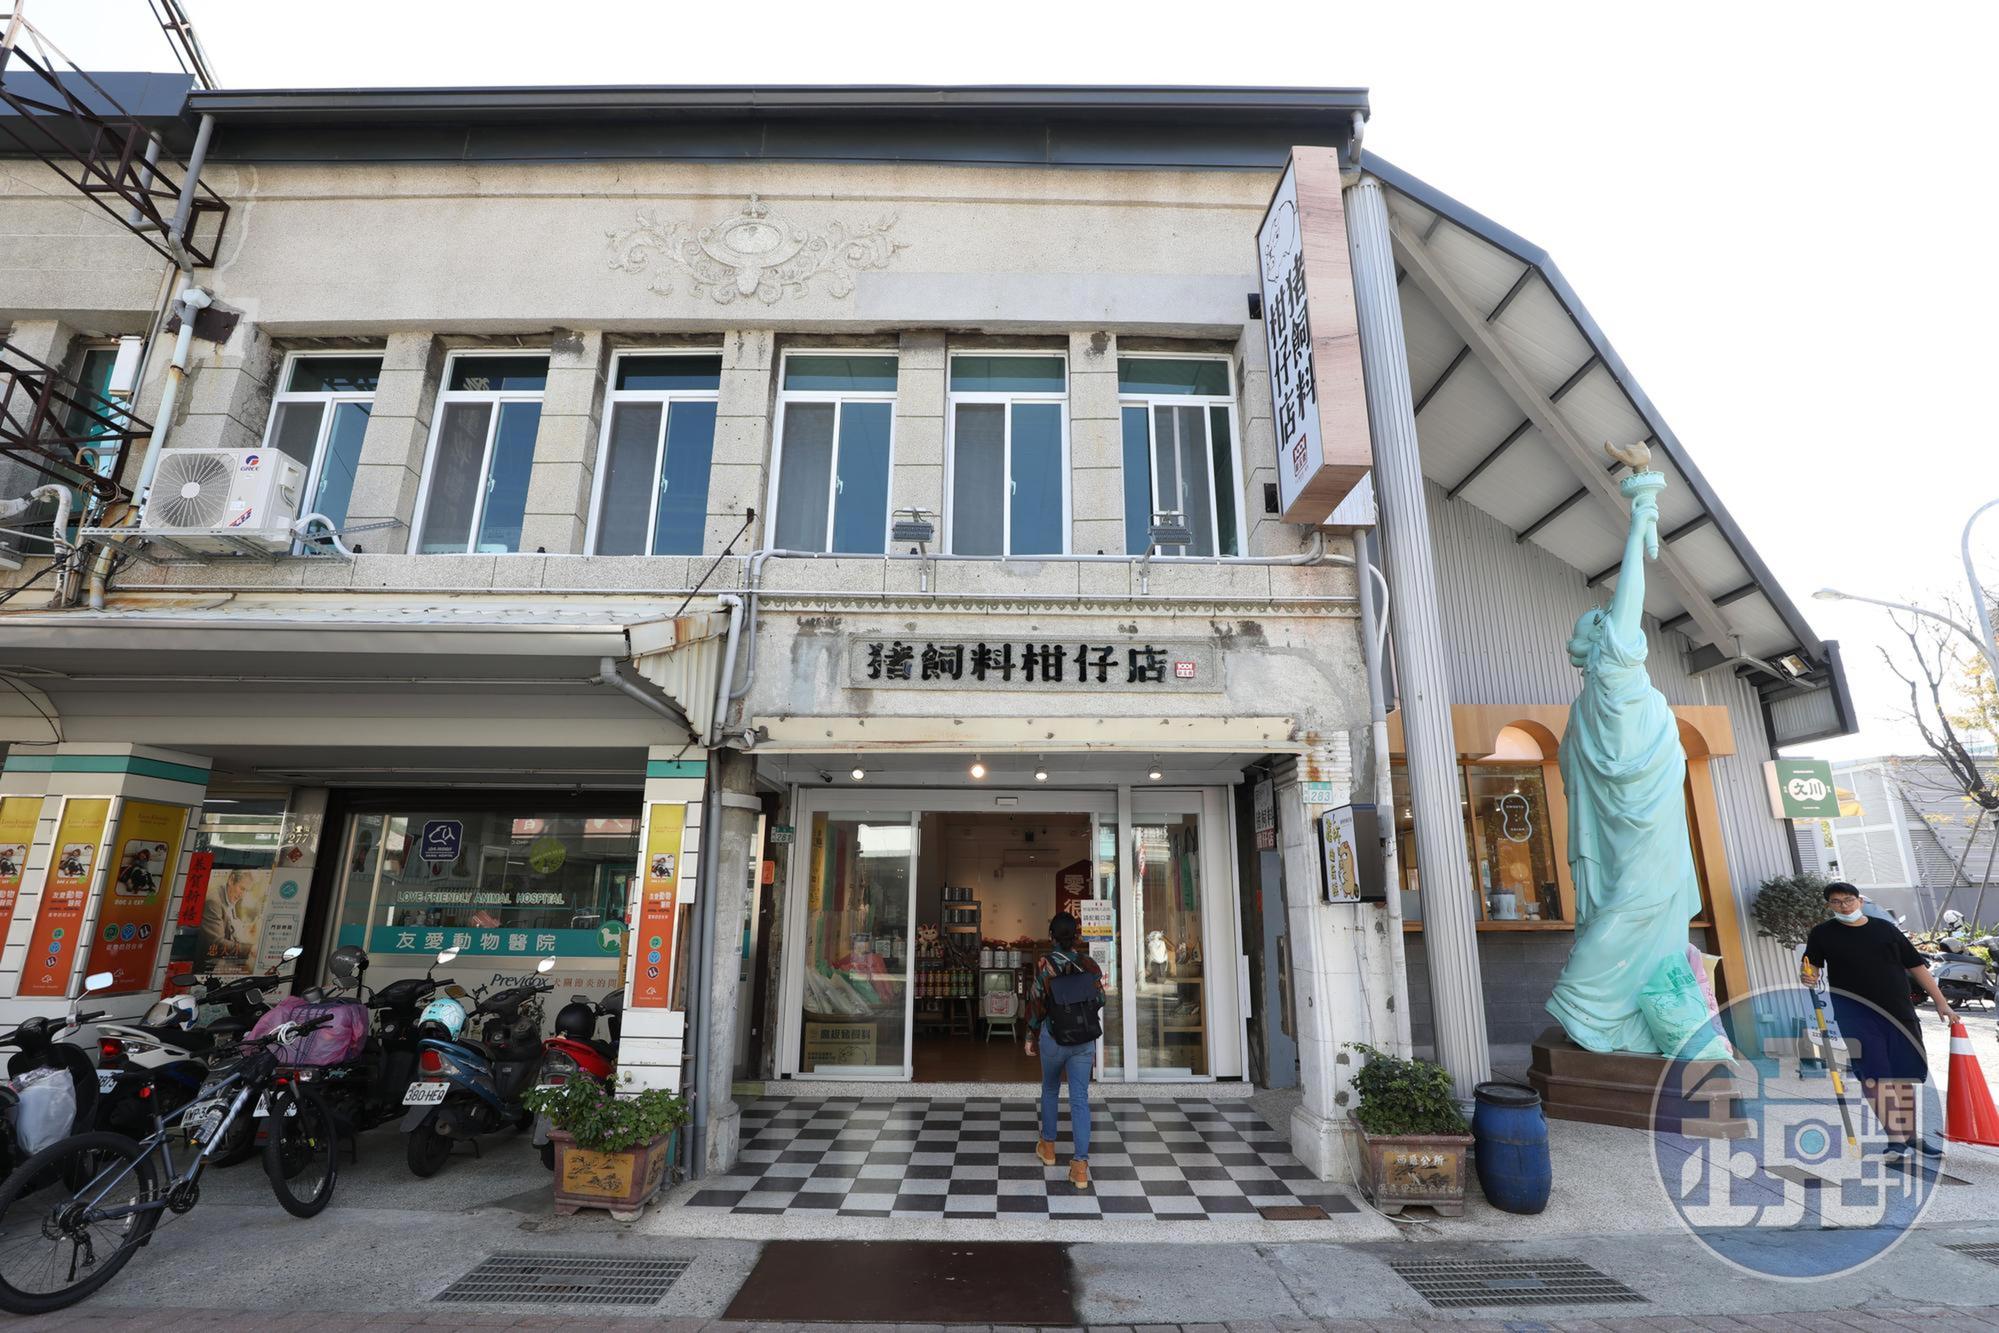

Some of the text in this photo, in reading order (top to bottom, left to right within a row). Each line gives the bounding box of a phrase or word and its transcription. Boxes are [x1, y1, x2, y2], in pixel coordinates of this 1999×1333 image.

[1269, 284, 1296, 452] 柑仔店
[866, 641, 1169, 682] 猪飼料柑仔店
[1311, 791, 1330, 801] 283
[1793, 782, 1822, 796] 文川
[288, 833, 309, 844] 277
[474, 892, 512, 904] ANIMAL
[516, 892, 565, 905] HOSPITAL
[396, 931, 557, 951] 友愛動物醫院
